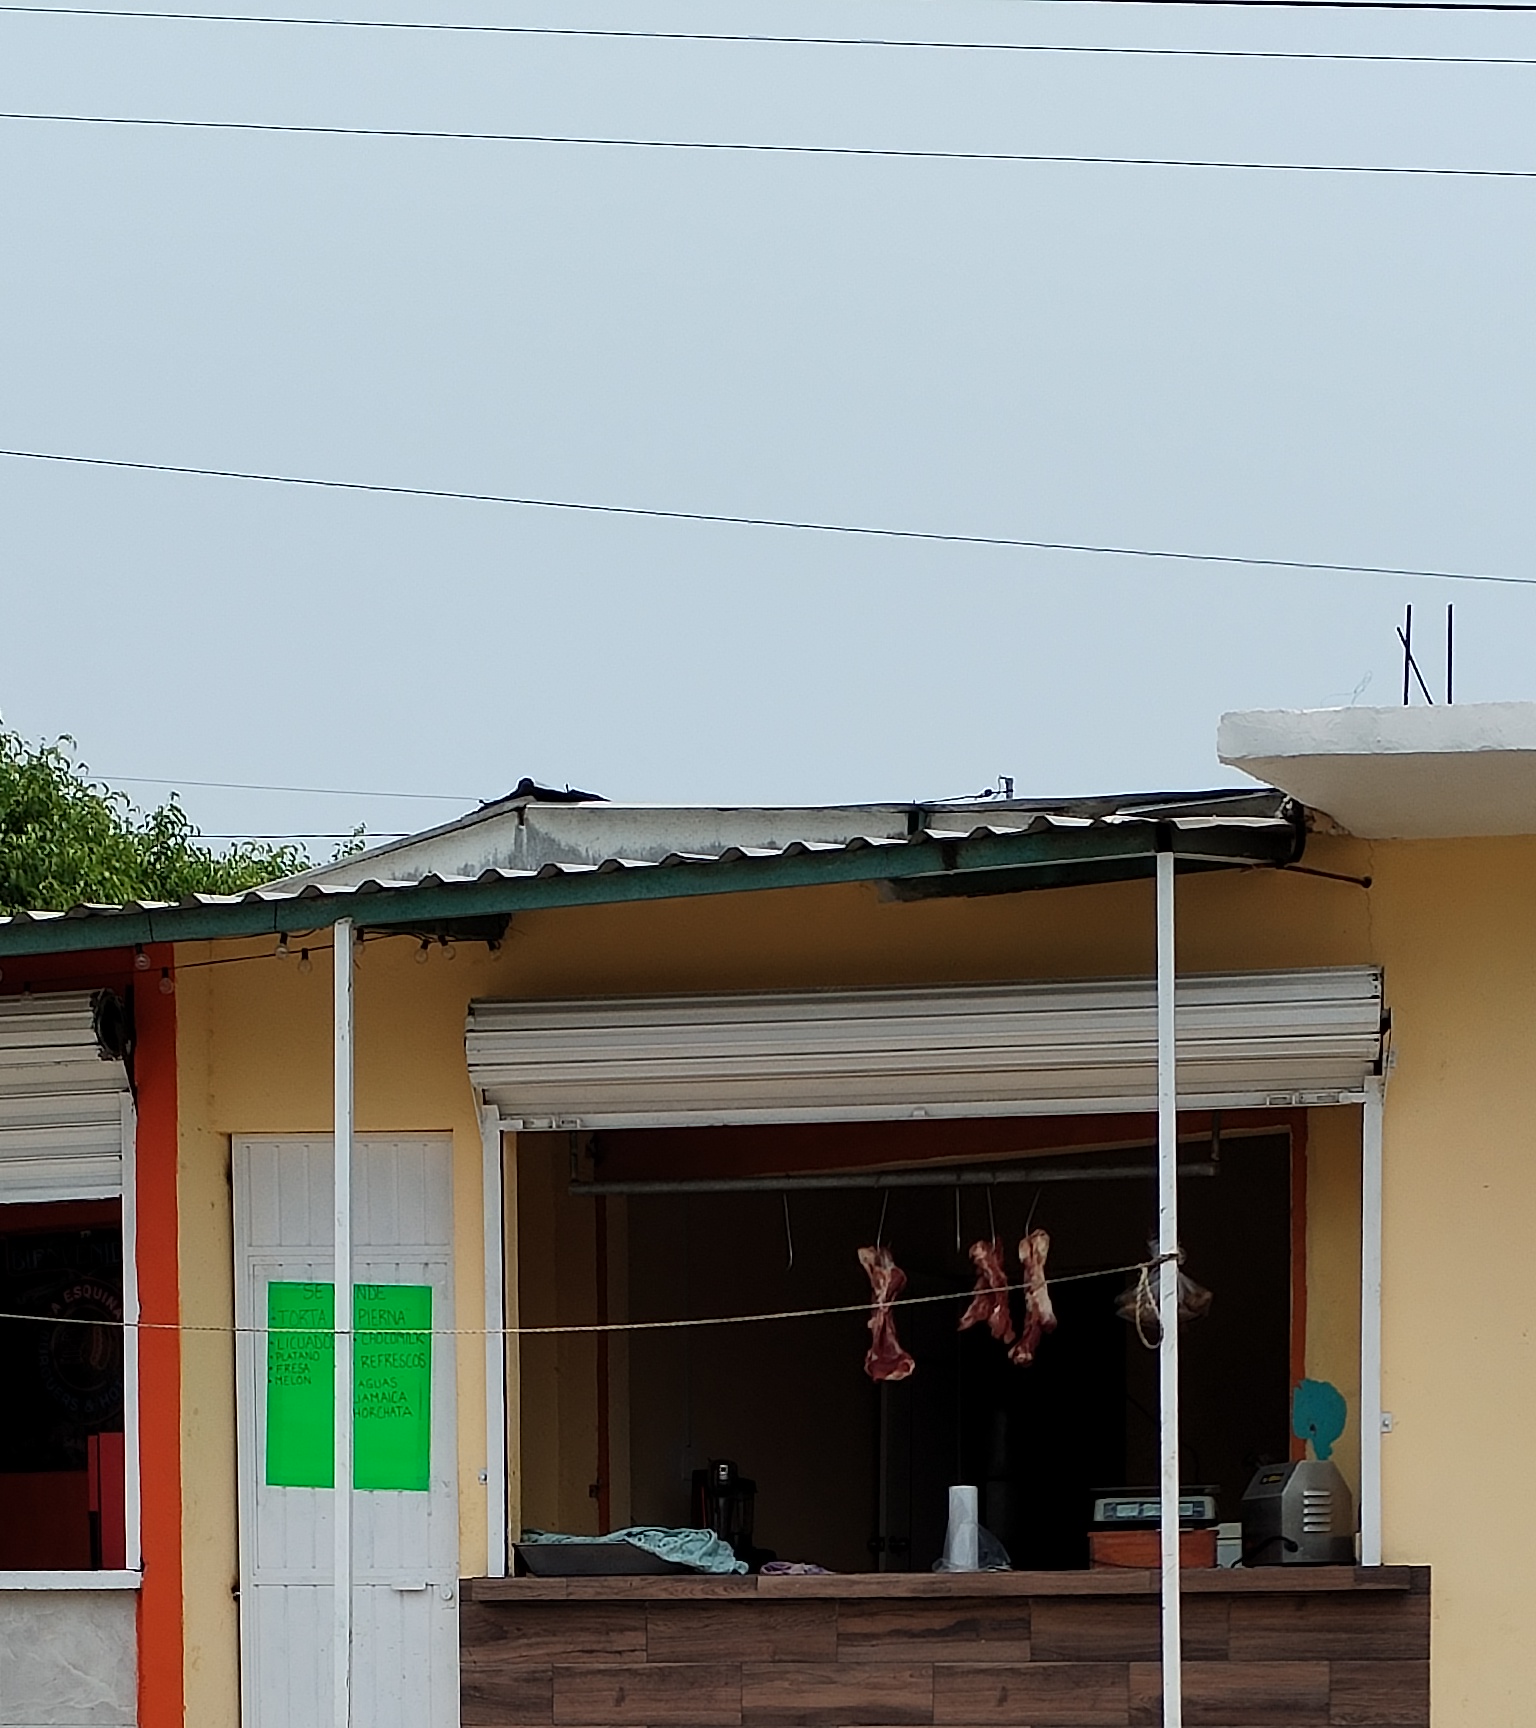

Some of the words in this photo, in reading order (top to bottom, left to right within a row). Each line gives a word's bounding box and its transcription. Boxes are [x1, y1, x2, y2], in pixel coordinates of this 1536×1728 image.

[302, 1286, 324, 1300] SE
[62, 1284, 122, 1321] ESQUINA
[277, 1308, 326, 1326] TORTA
[358, 1308, 406, 1326] PIERNA
[275, 1350, 321, 1362] PLATANO
[360, 1352, 427, 1370] REFRESCOS
[276, 1362, 311, 1374] FRESA
[275, 1375, 312, 1386] MELON
[357, 1376, 398, 1389] AGUAS
[354, 1390, 409, 1405] JAMAICA
[353, 1405, 414, 1420] HORCHATA
